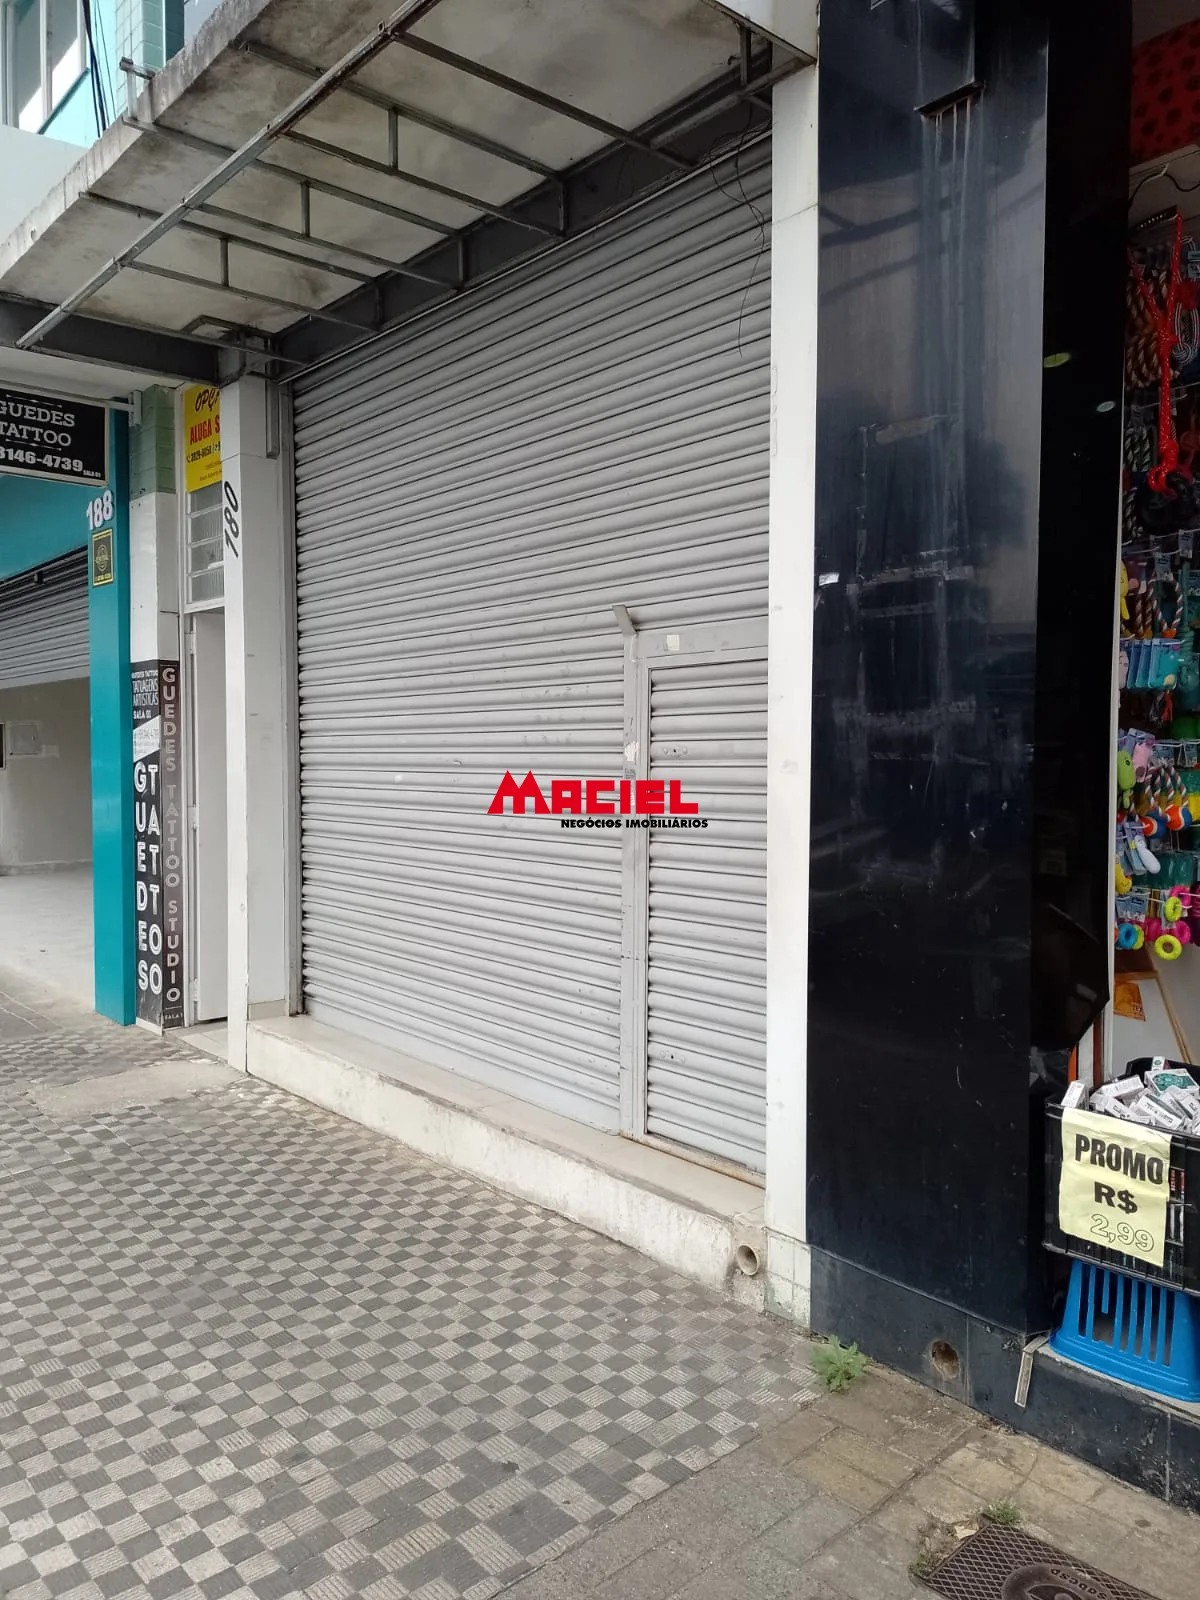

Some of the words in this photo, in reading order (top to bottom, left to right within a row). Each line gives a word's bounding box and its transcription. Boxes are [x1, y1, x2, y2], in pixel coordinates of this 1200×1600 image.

[0, 400, 76, 427] GUEDES
[190, 418, 212, 445] ALUGA
[0, 421, 71, 446] TATTOO
[86, 490, 113, 530] 188
[225, 481, 239, 558] 180
[133, 709, 145, 719] SALA
[161, 667, 177, 772] GUEDES
[165, 784, 180, 888] TATTOO
[166, 900, 181, 1001] STUDIO
[1075, 1133, 1163, 1185] PROMO
[1094, 1181, 1138, 1215] R$
[1090, 1213, 1154, 1252] 2,99
